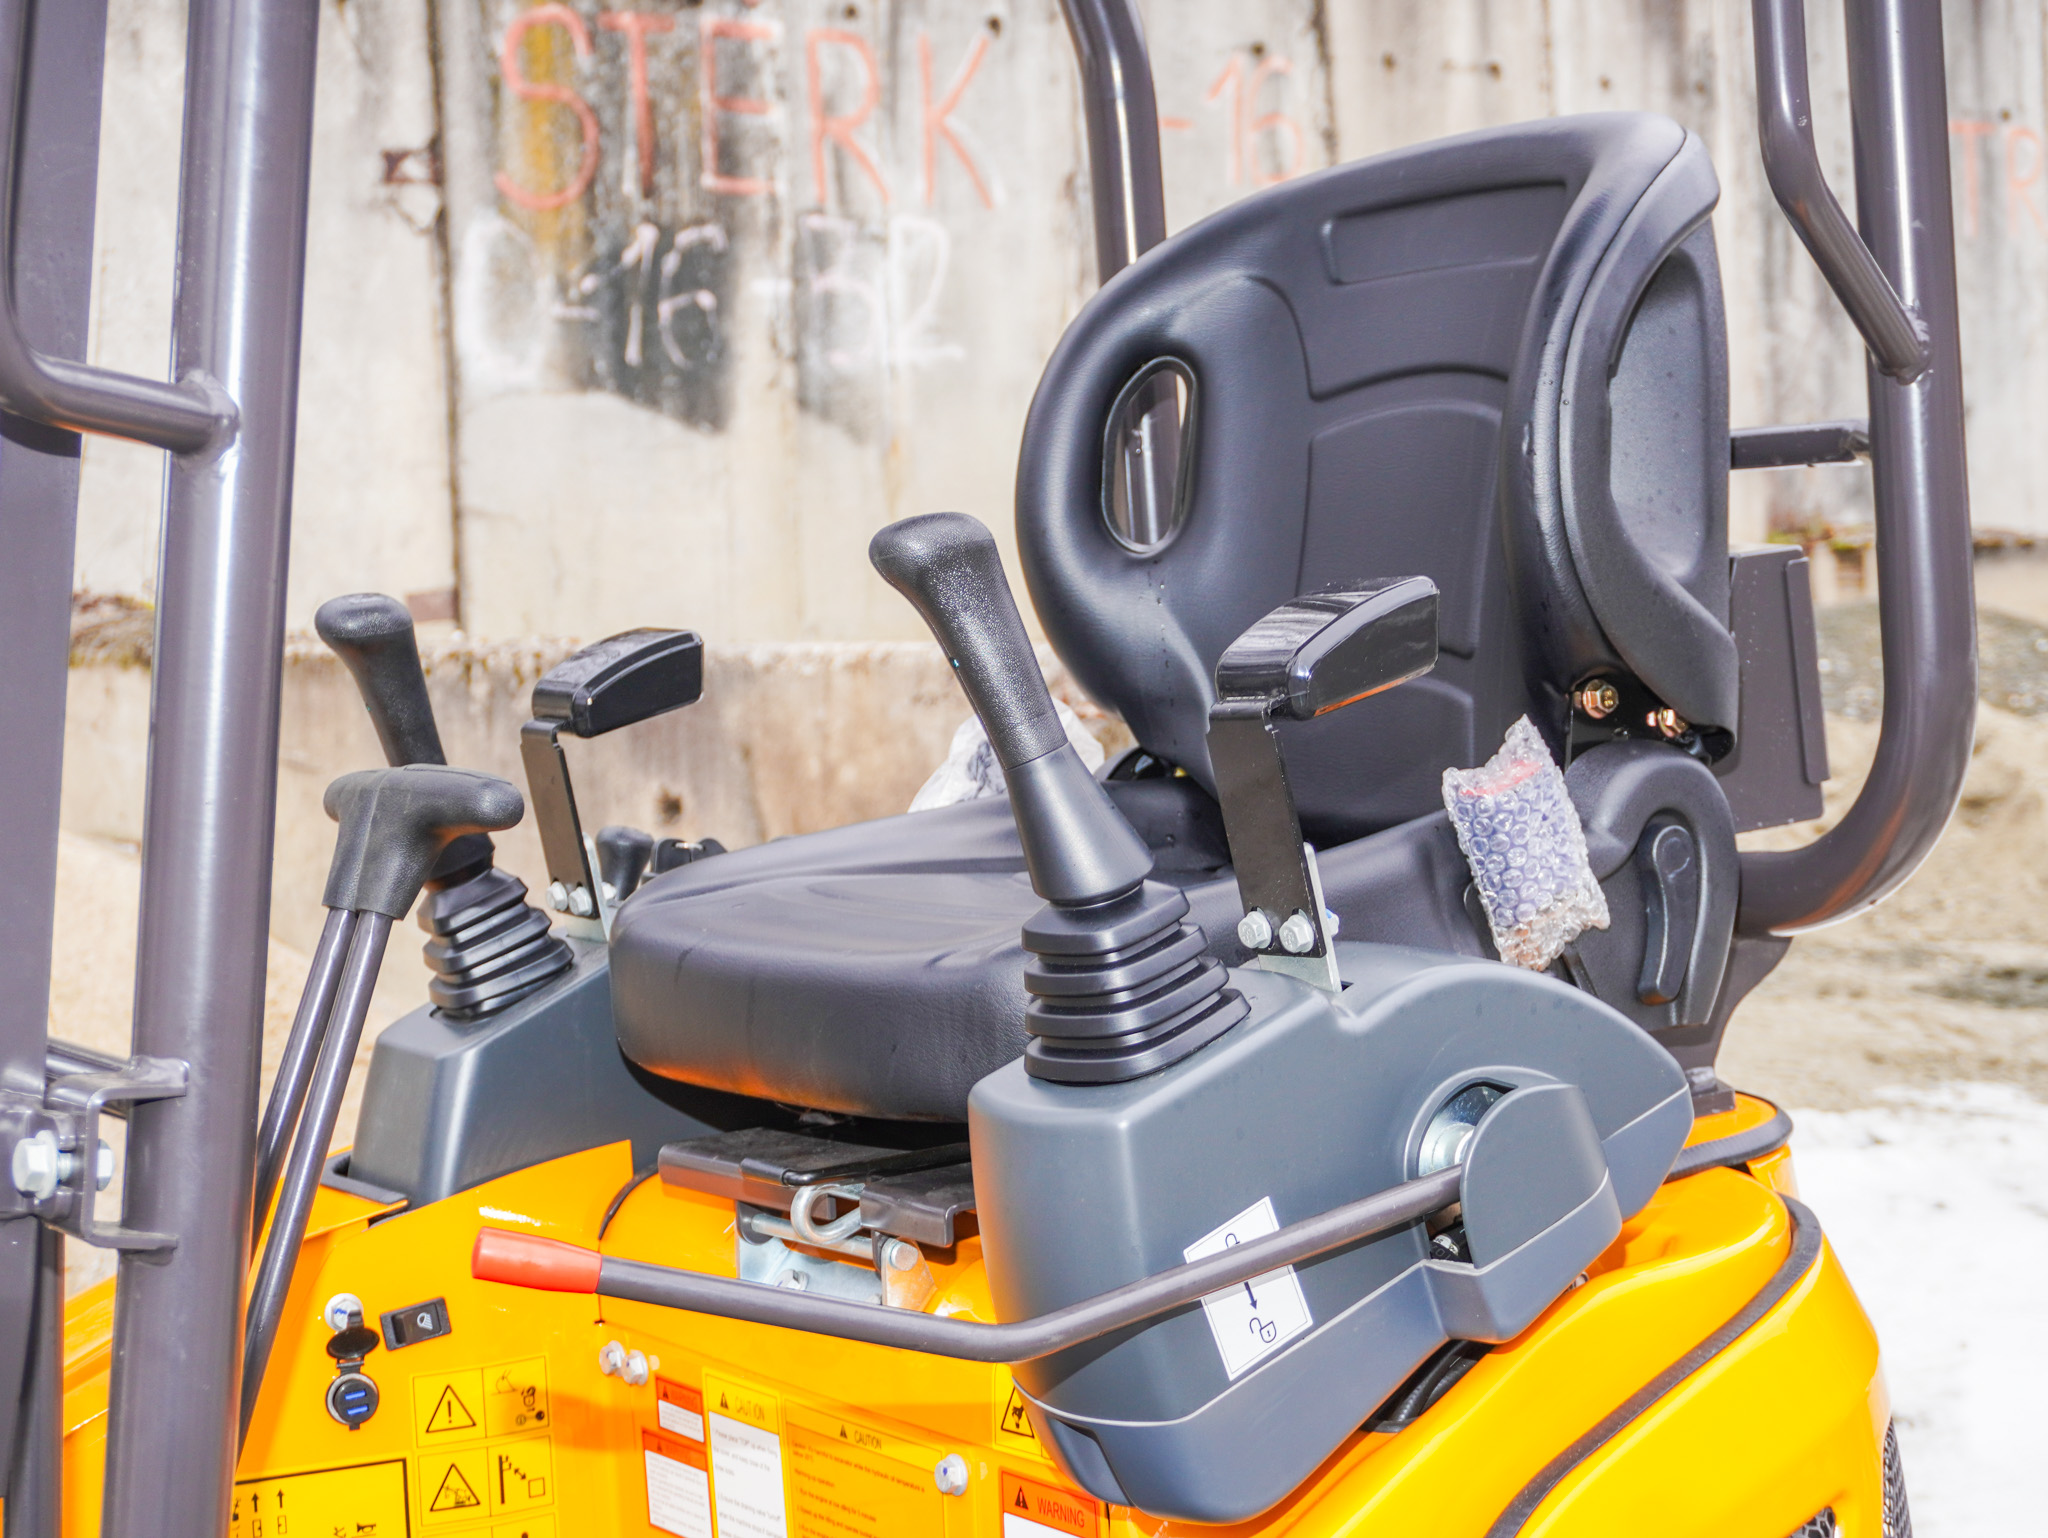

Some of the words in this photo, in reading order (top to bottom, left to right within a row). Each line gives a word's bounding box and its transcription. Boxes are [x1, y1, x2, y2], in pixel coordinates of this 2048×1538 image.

[495, 3, 997, 210] STERK
[854, 1430, 882, 1450] CAUTION
[1037, 1496, 1085, 1528] WARNING
